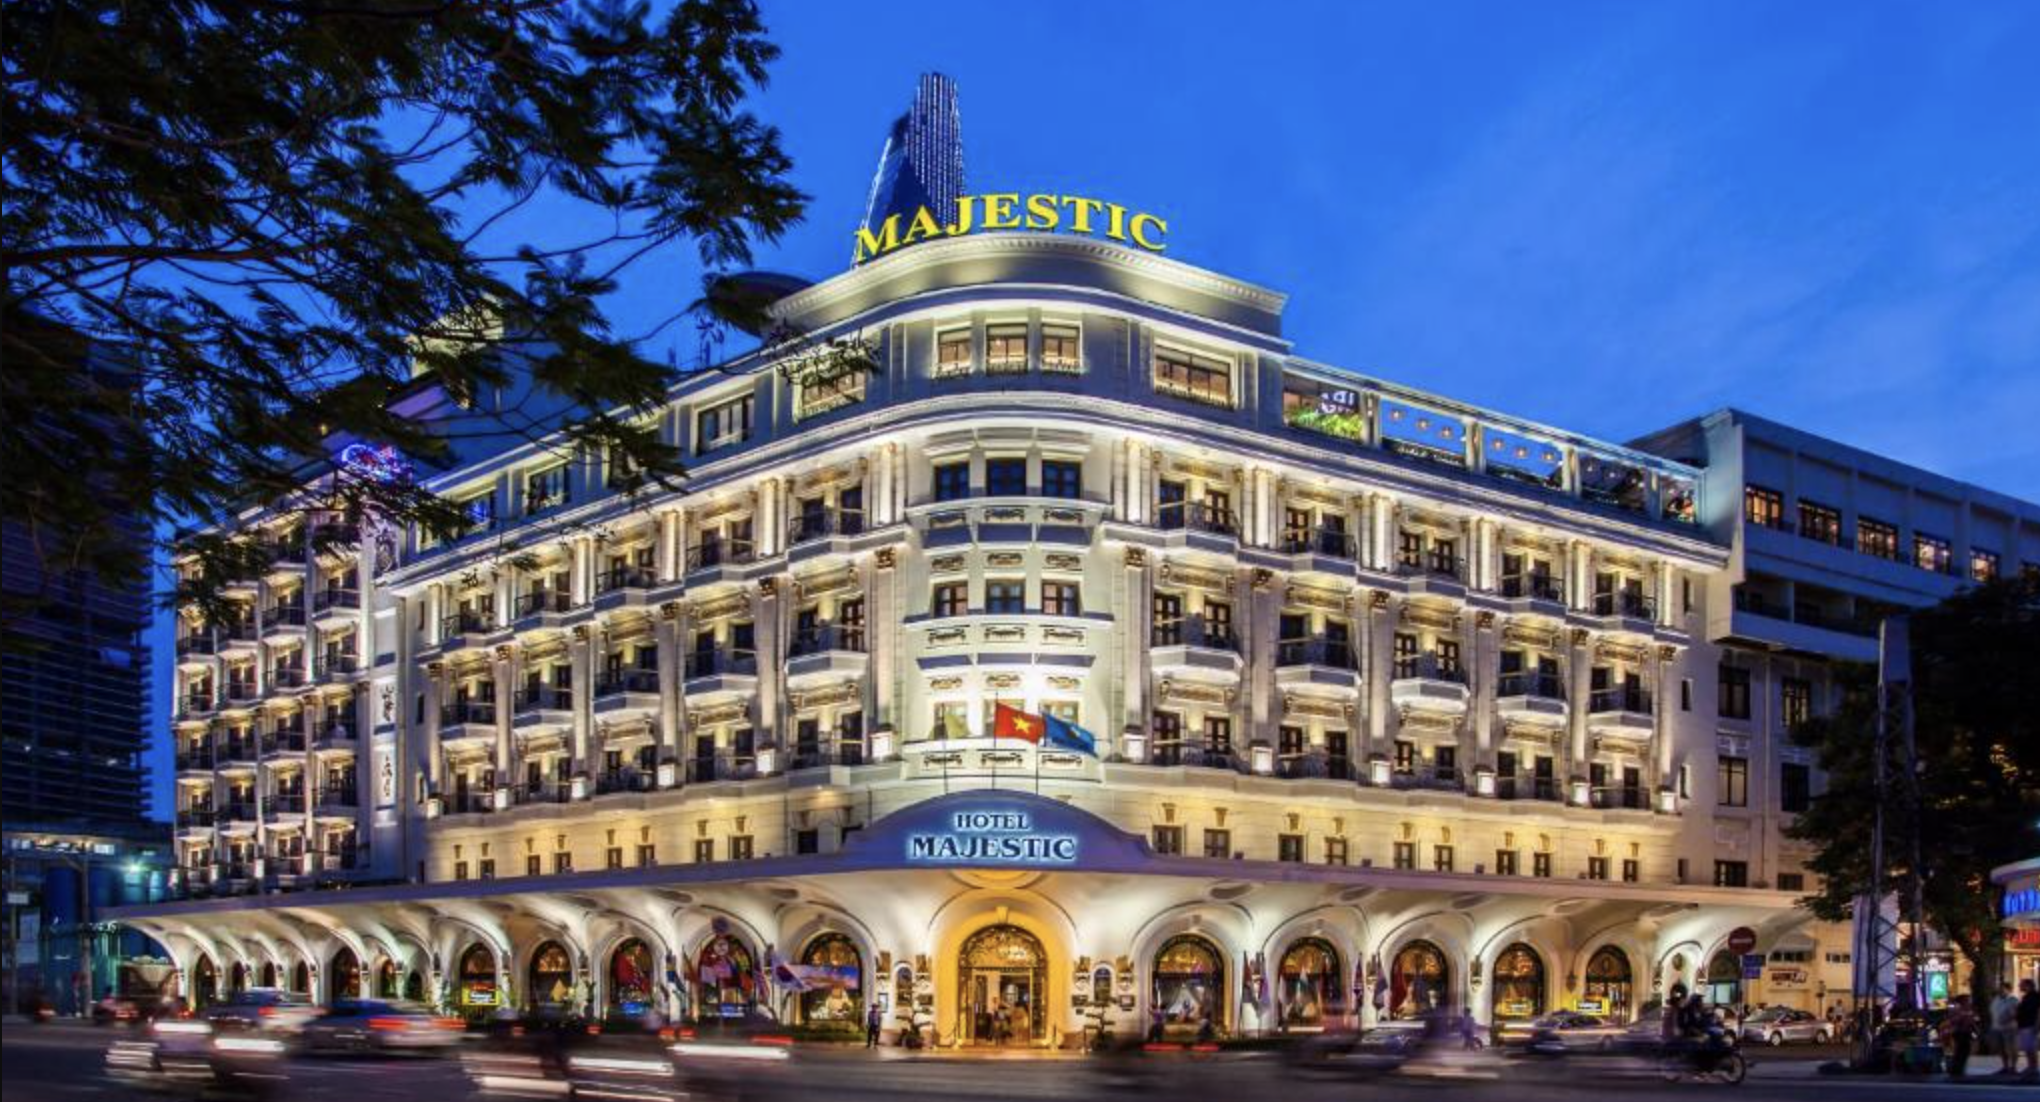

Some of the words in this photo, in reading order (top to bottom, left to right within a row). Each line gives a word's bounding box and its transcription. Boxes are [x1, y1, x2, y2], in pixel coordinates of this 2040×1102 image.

[854, 193, 1168, 261] MAJESTIC
[956, 812, 1029, 830] HOTEL
[911, 835, 1076, 861] MAJESTIC
